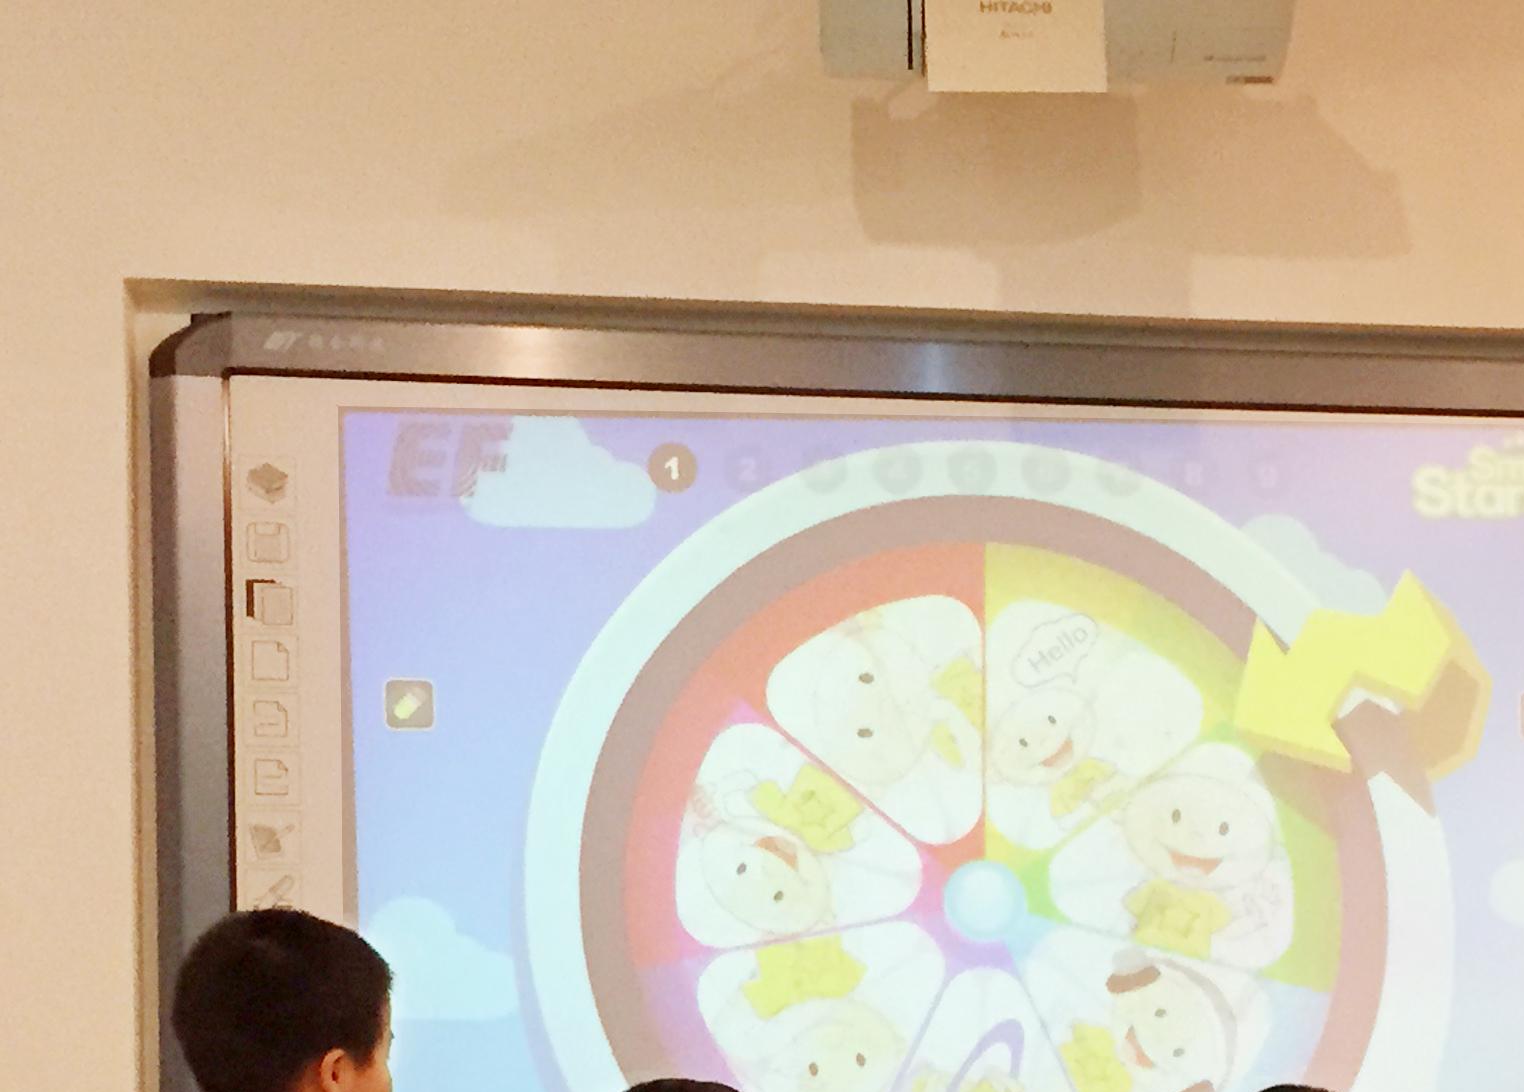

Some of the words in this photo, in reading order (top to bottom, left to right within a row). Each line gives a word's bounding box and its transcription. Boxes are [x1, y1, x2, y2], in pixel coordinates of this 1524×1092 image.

[978, 0, 1053, 14] HITACHI
[388, 420, 514, 497] EF
[663, 456, 680, 481] 1
[1026, 624, 1089, 673] Hello
